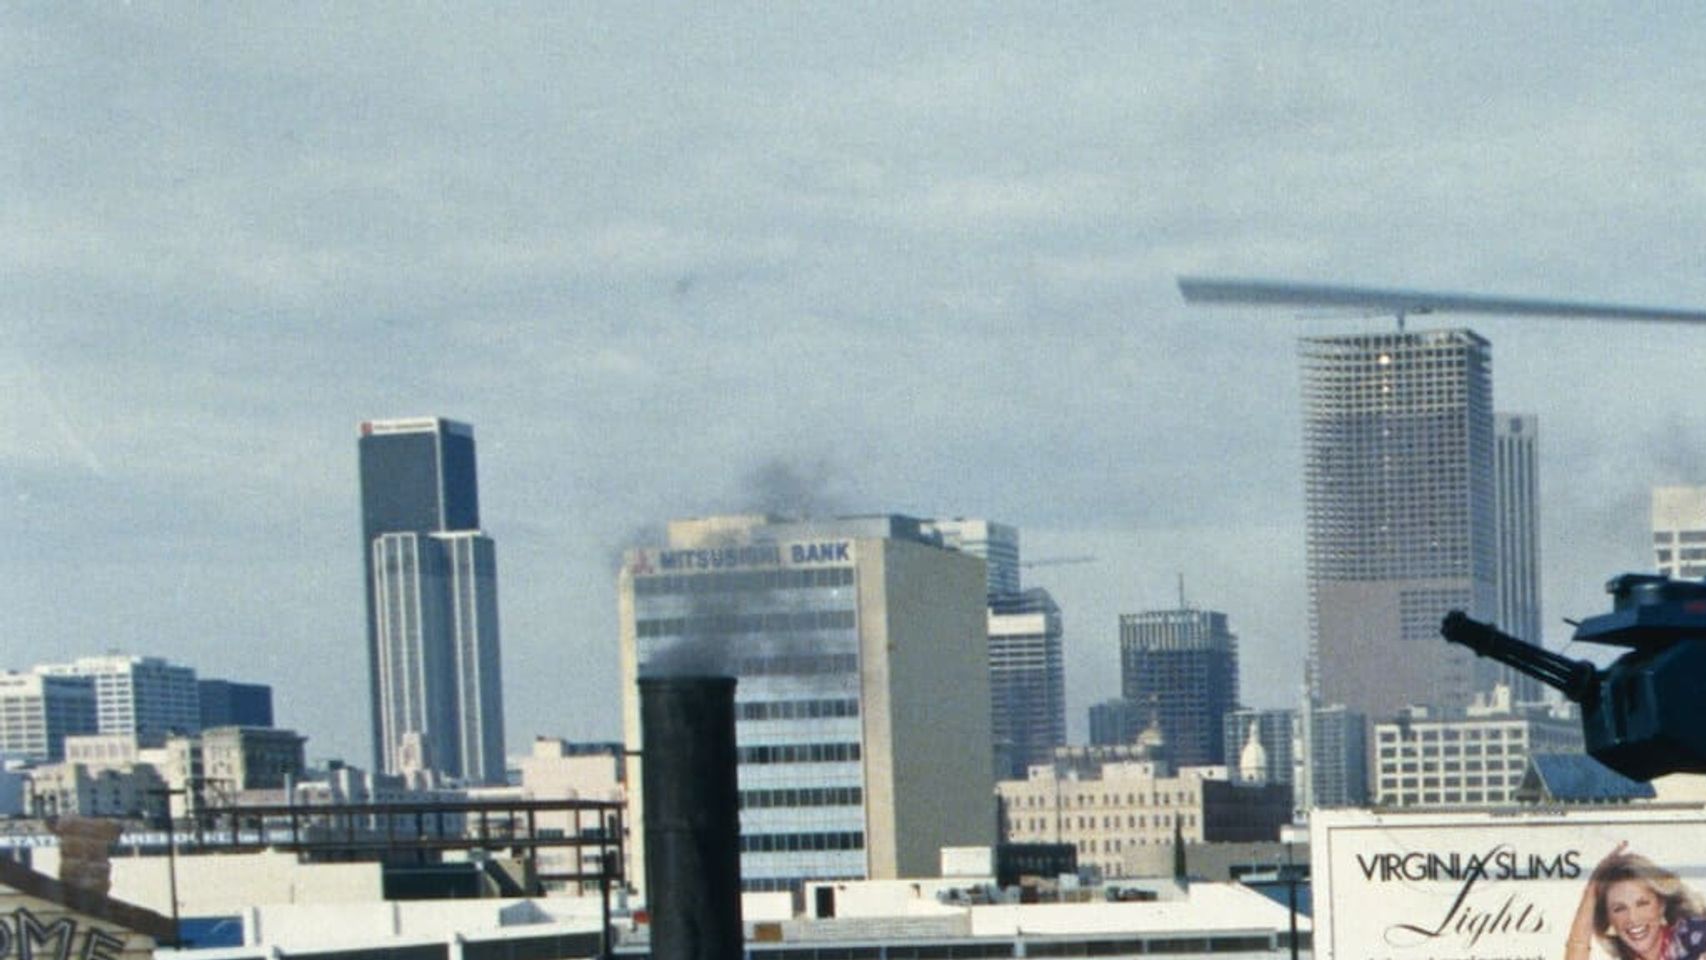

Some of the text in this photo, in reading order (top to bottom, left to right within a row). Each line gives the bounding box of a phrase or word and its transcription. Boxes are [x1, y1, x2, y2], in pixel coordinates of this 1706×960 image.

[792, 542, 849, 563] BANK
[1357, 850, 1580, 881] VIRGINIA SLIMS
[1384, 844, 1548, 948] Lights
